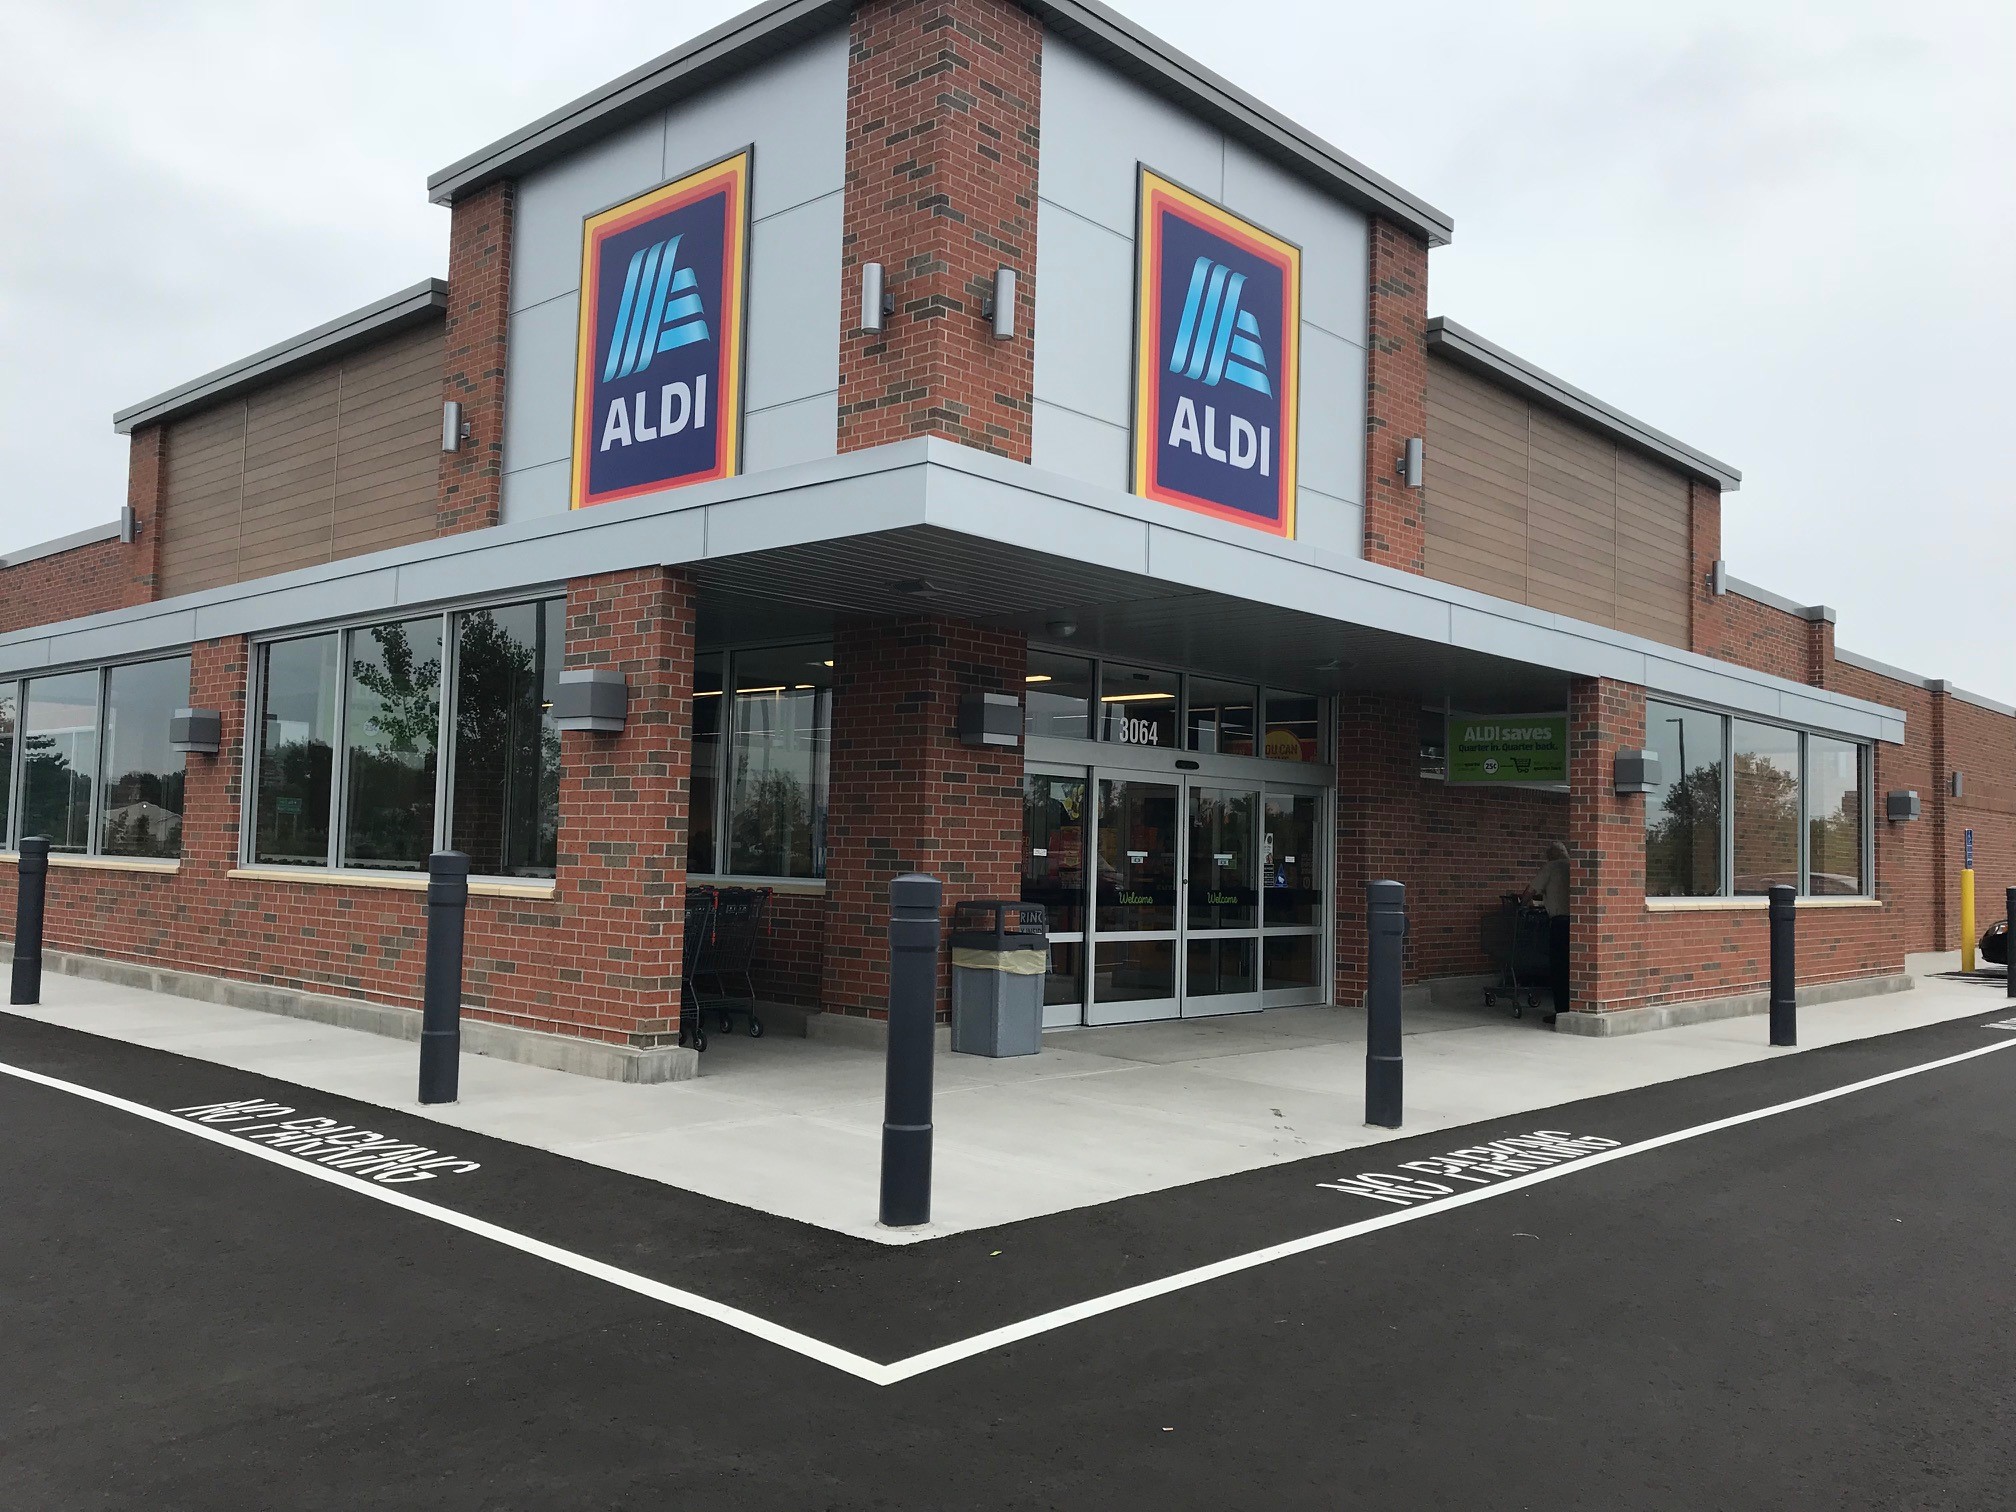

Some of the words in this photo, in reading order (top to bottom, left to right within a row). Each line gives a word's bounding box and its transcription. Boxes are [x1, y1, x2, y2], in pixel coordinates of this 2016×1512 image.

[600, 374, 707, 452] ALDI
[1168, 395, 1271, 477] ALDI
[1119, 717, 1159, 746] 3064
[1464, 726, 1500, 741] ALDI
[1502, 726, 1553, 741] saves
[1265, 744, 1277, 755] OU
[1279, 744, 1298, 755] CAN
[1459, 743, 1489, 752] Quarter
[1491, 742, 1501, 752] in.
[1502, 743, 1534, 752] Quarter
[1535, 742, 1559, 751] back.
[1485, 762, 1497, 770] 25¢
[1118, 891, 1154, 905] Welcome
[1206, 892, 1239, 905] Welcome
[170, 1098, 296, 1122] NO
[230, 1116, 482, 1183] PARKING
[1315, 1173, 1454, 1206] NO
[1397, 1130, 1622, 1184] PARKING
